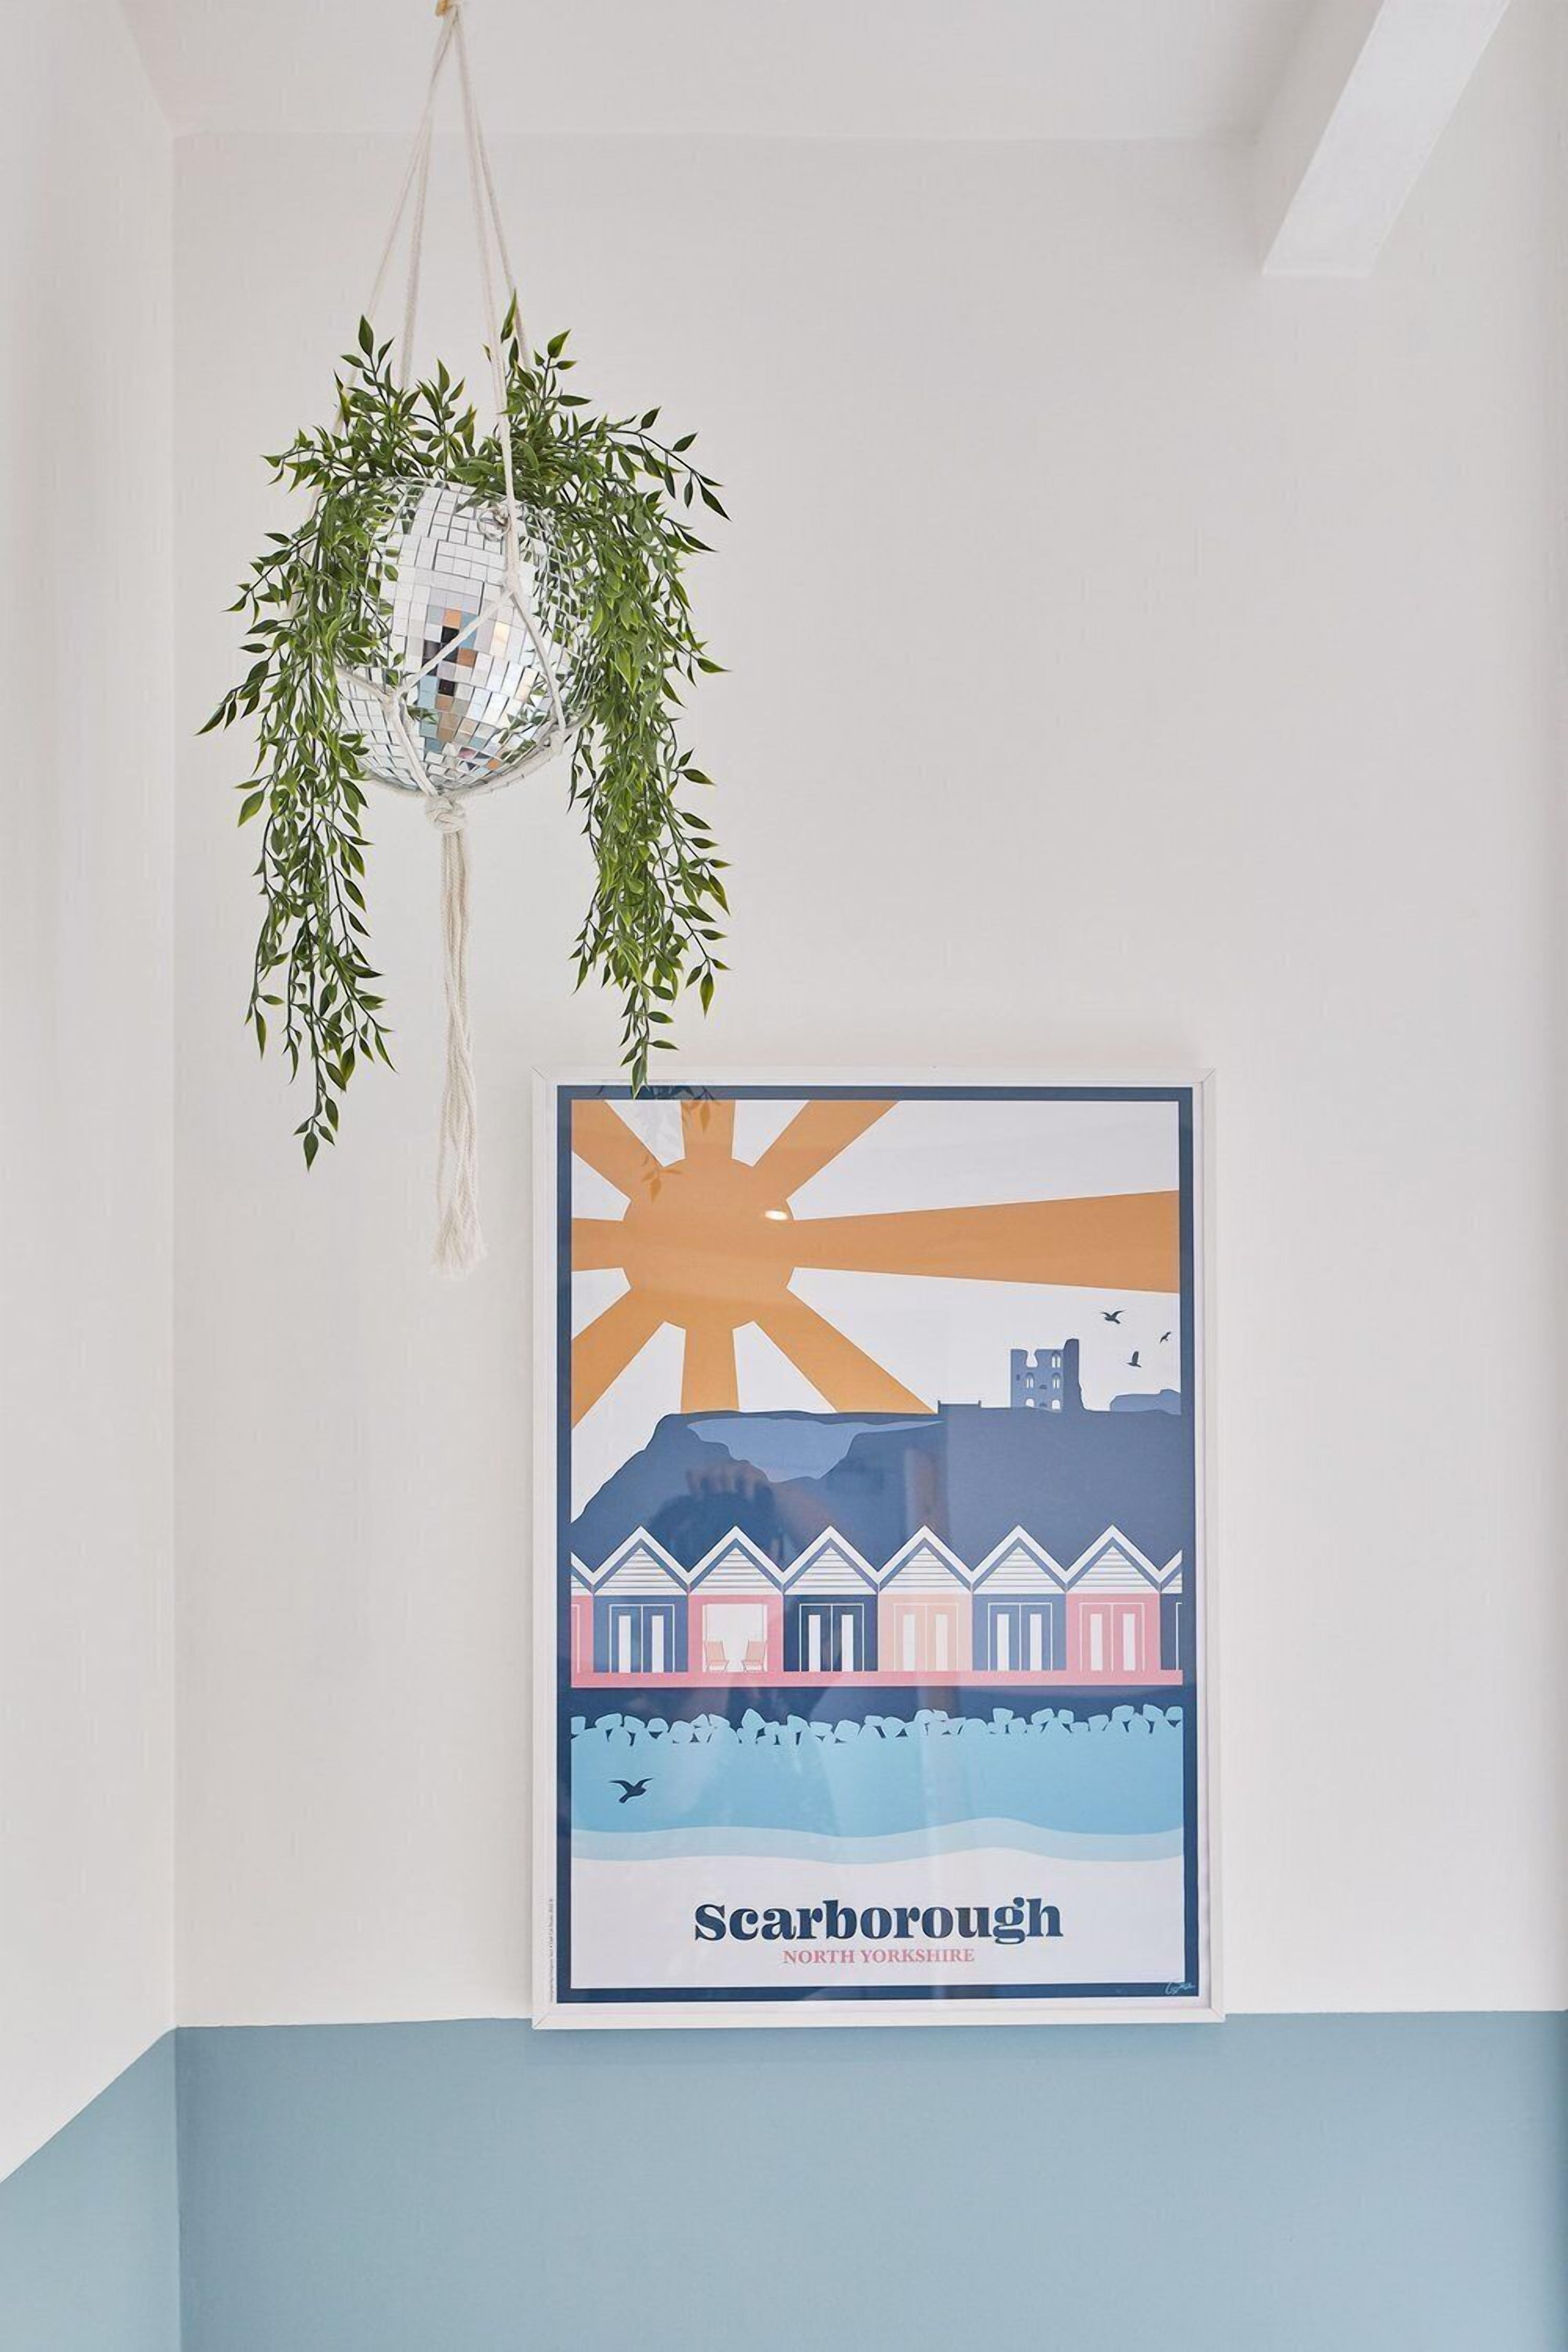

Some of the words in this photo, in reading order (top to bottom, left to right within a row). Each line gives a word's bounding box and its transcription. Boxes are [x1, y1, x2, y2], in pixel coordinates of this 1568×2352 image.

[694, 1896, 1063, 1945] Scarborough
[784, 1949, 855, 1964] NORTH
[861, 1949, 975, 1962] YORKSHIRE
